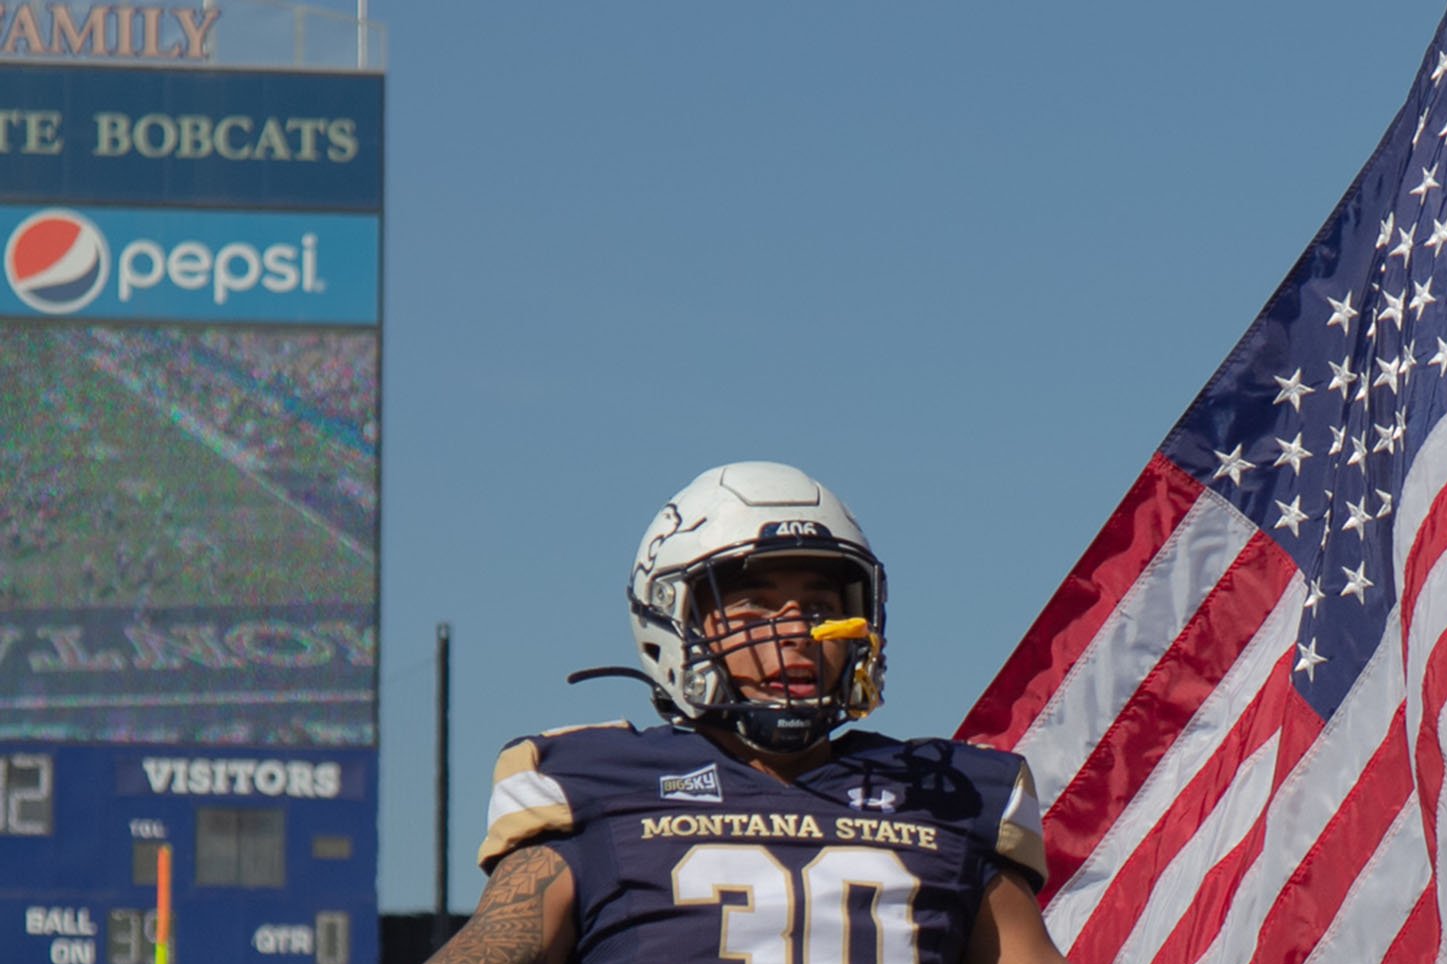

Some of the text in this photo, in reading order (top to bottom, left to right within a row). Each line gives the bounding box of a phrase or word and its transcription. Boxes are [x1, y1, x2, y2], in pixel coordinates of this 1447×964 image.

[0, 5, 219, 58] AMILY
[93, 113, 359, 163] BOBCATS
[118, 233, 317, 303] pepsi
[776, 522, 817, 536] 406
[143, 757, 341, 798] VISITORS
[641, 813, 937, 850] MONTANA STATE
[26, 907, 97, 936] BALL
[254, 925, 314, 955] QTR
